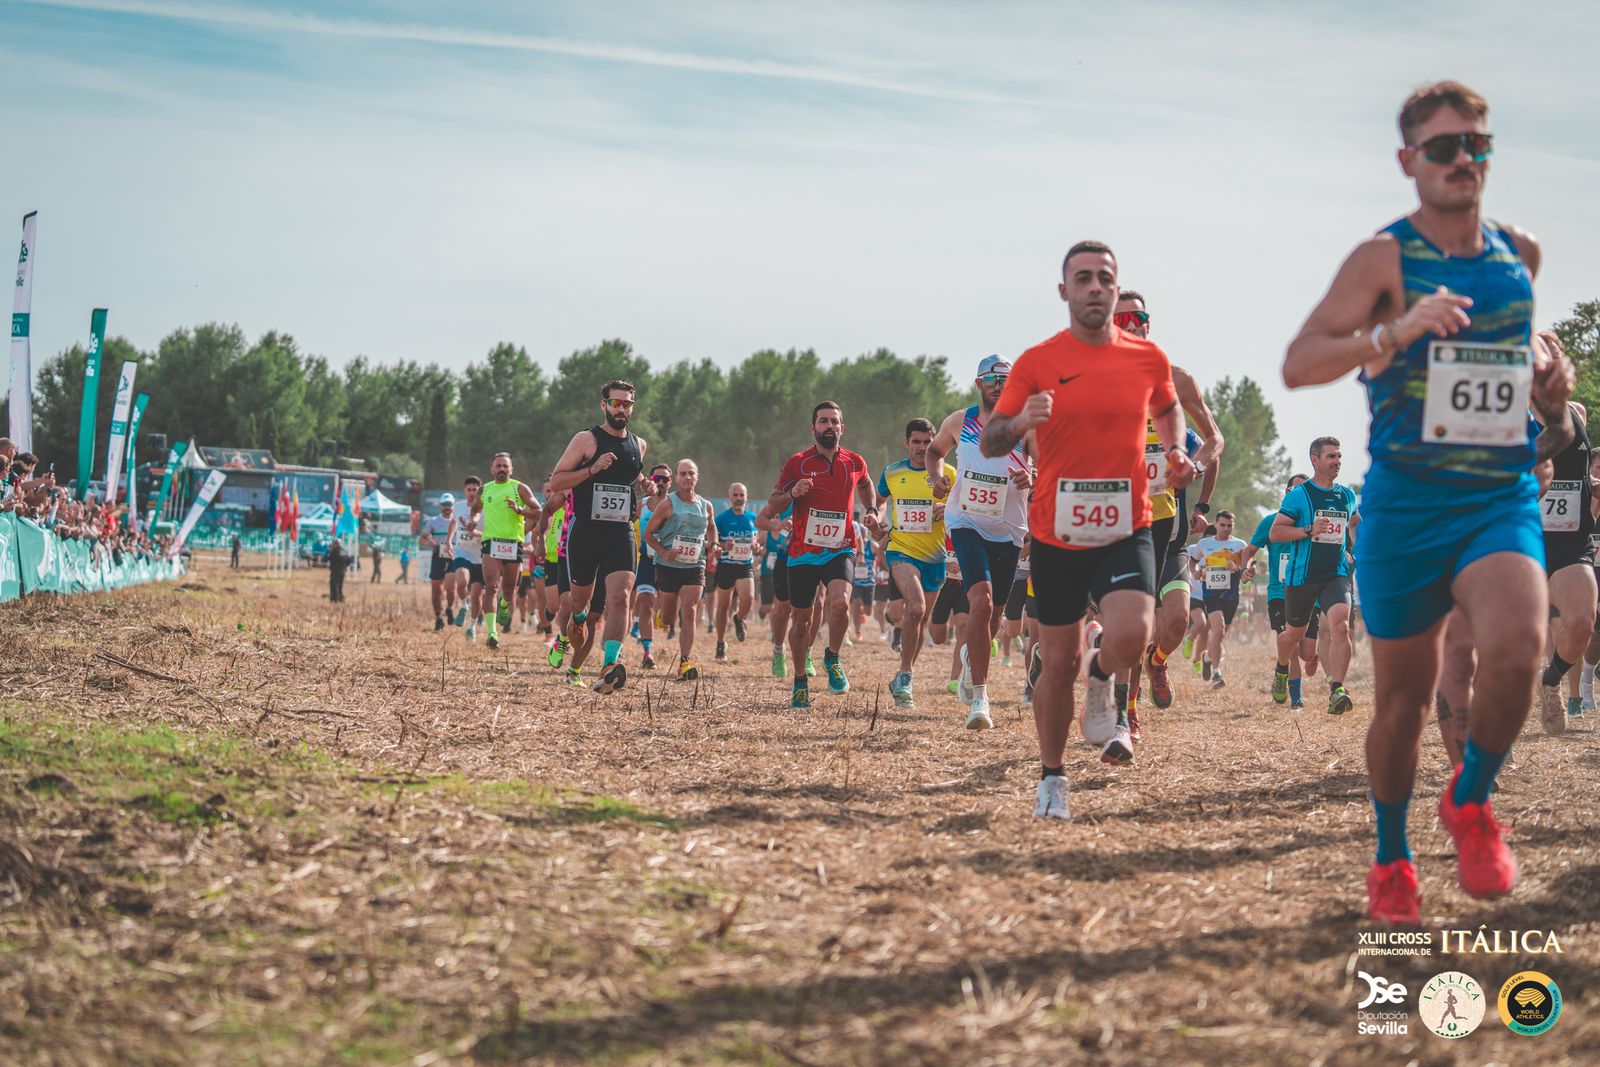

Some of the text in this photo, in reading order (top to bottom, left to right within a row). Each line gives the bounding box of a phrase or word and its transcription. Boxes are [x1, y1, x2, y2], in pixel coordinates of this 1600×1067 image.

[1451, 379, 1514, 413] 619
[968, 487, 998, 505] 535
[600, 497, 625, 510] 357
[903, 511, 926, 522] 138
[1072, 504, 1119, 528] 549
[814, 524, 840, 537] 107
[1326, 523, 1342, 534] 34
[496, 544, 513, 553] 154
[677, 545, 697, 556] 316
[1210, 574, 1227, 582] 859
